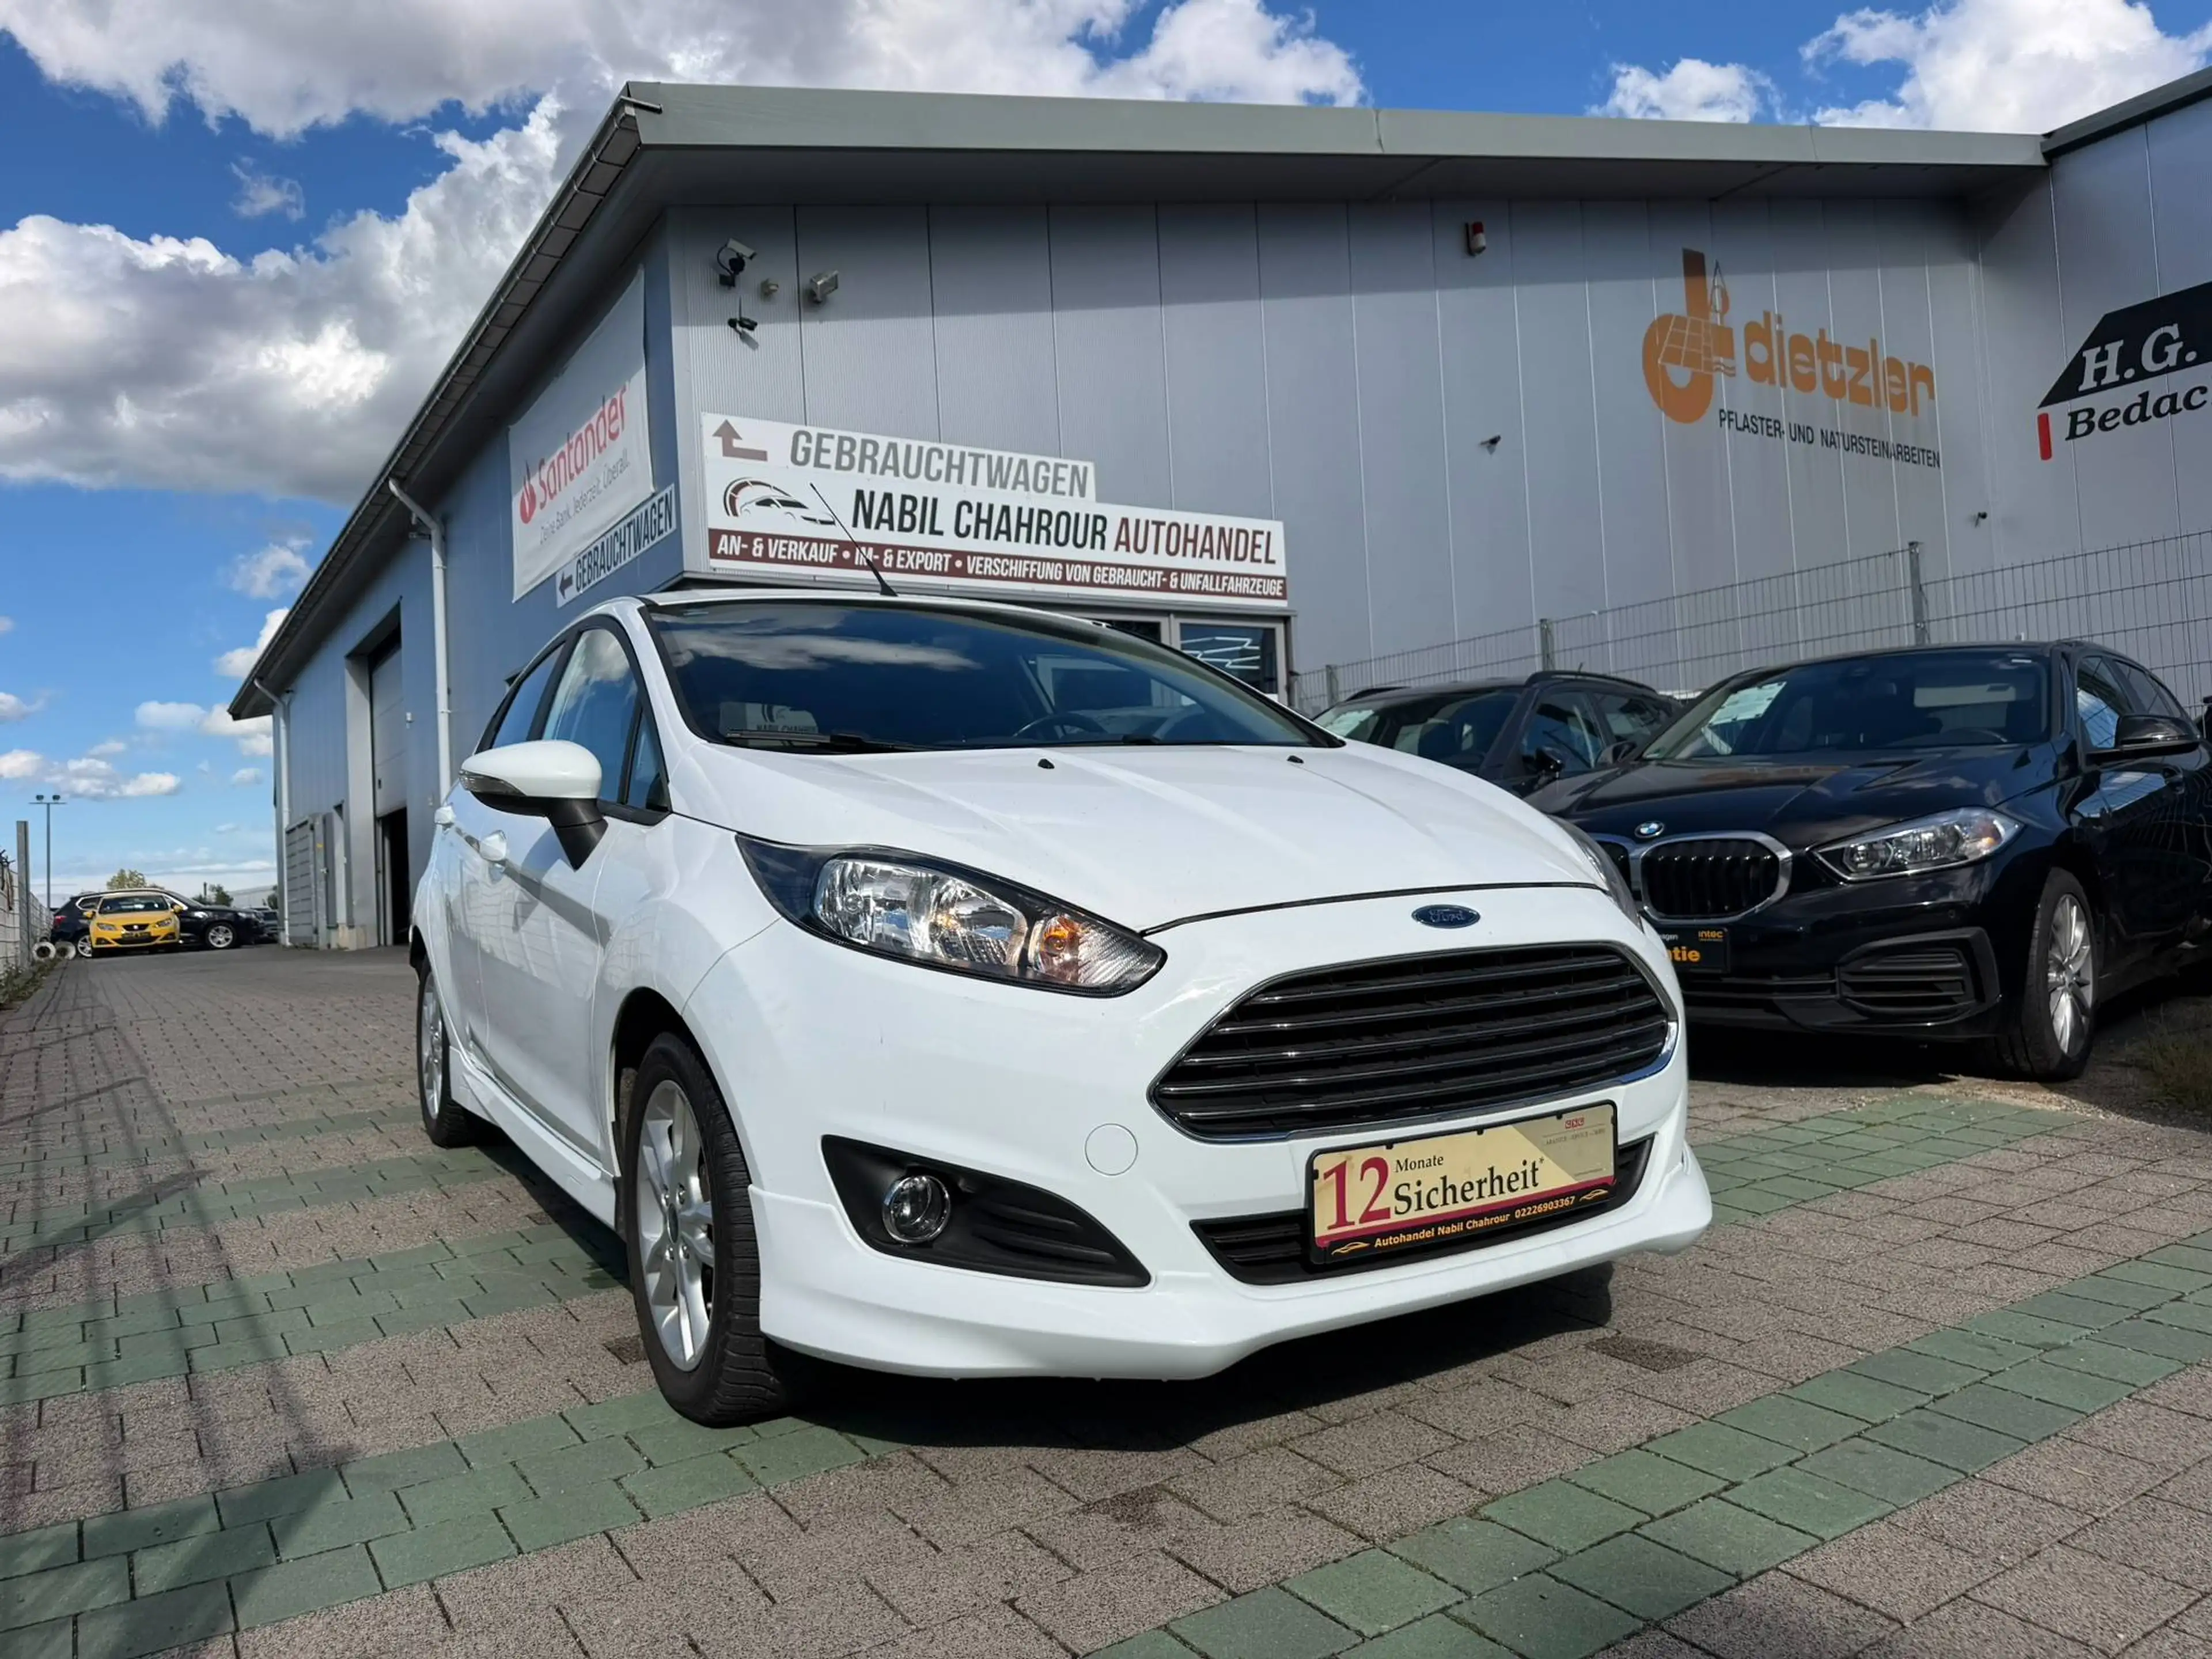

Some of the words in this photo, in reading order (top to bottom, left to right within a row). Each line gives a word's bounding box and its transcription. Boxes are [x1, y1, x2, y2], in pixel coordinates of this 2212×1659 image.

[1744, 310, 1936, 416] dietzler
[2078, 323, 2198, 392] H.G.
[1719, 408, 1785, 439] PFLASTER-
[1788, 426, 1815, 444] UND
[1820, 429, 1941, 468] NATURSTEINARBEITEN
[2065, 377, 2212, 441] Bedac
[539, 384, 627, 510] Santander
[790, 429, 1088, 498] GEBRAUCHTWAGEN
[576, 489, 673, 593] GEBRAUCHTWAGEN
[851, 489, 944, 537] NABIL
[953, 499, 1108, 551] CHAHROUR
[1113, 517, 1276, 565] AUTOHANDEL
[717, 534, 748, 556] AN-
[752, 537, 764, 558] &
[767, 539, 839, 563] VERKAUF
[882, 548, 893, 568] &
[896, 549, 952, 572] EXPORT
[966, 555, 1063, 581] VERSCHIFFUNG
[1066, 563, 1092, 583] VON
[1093, 566, 1168, 589] GEBRAUCHT-
[1169, 571, 1179, 589] &
[1181, 572, 1284, 596] UNFALLFAHRZEUGE
[1323, 1156, 1391, 1230] 12
[1395, 1154, 1444, 1173] Monate
[1374, 1228, 1435, 1248] Autohandel
[1437, 1221, 1463, 1236] Nabil
[1465, 1214, 1510, 1230] Chahrour
[1514, 1196, 1575, 1219] 02226903367
